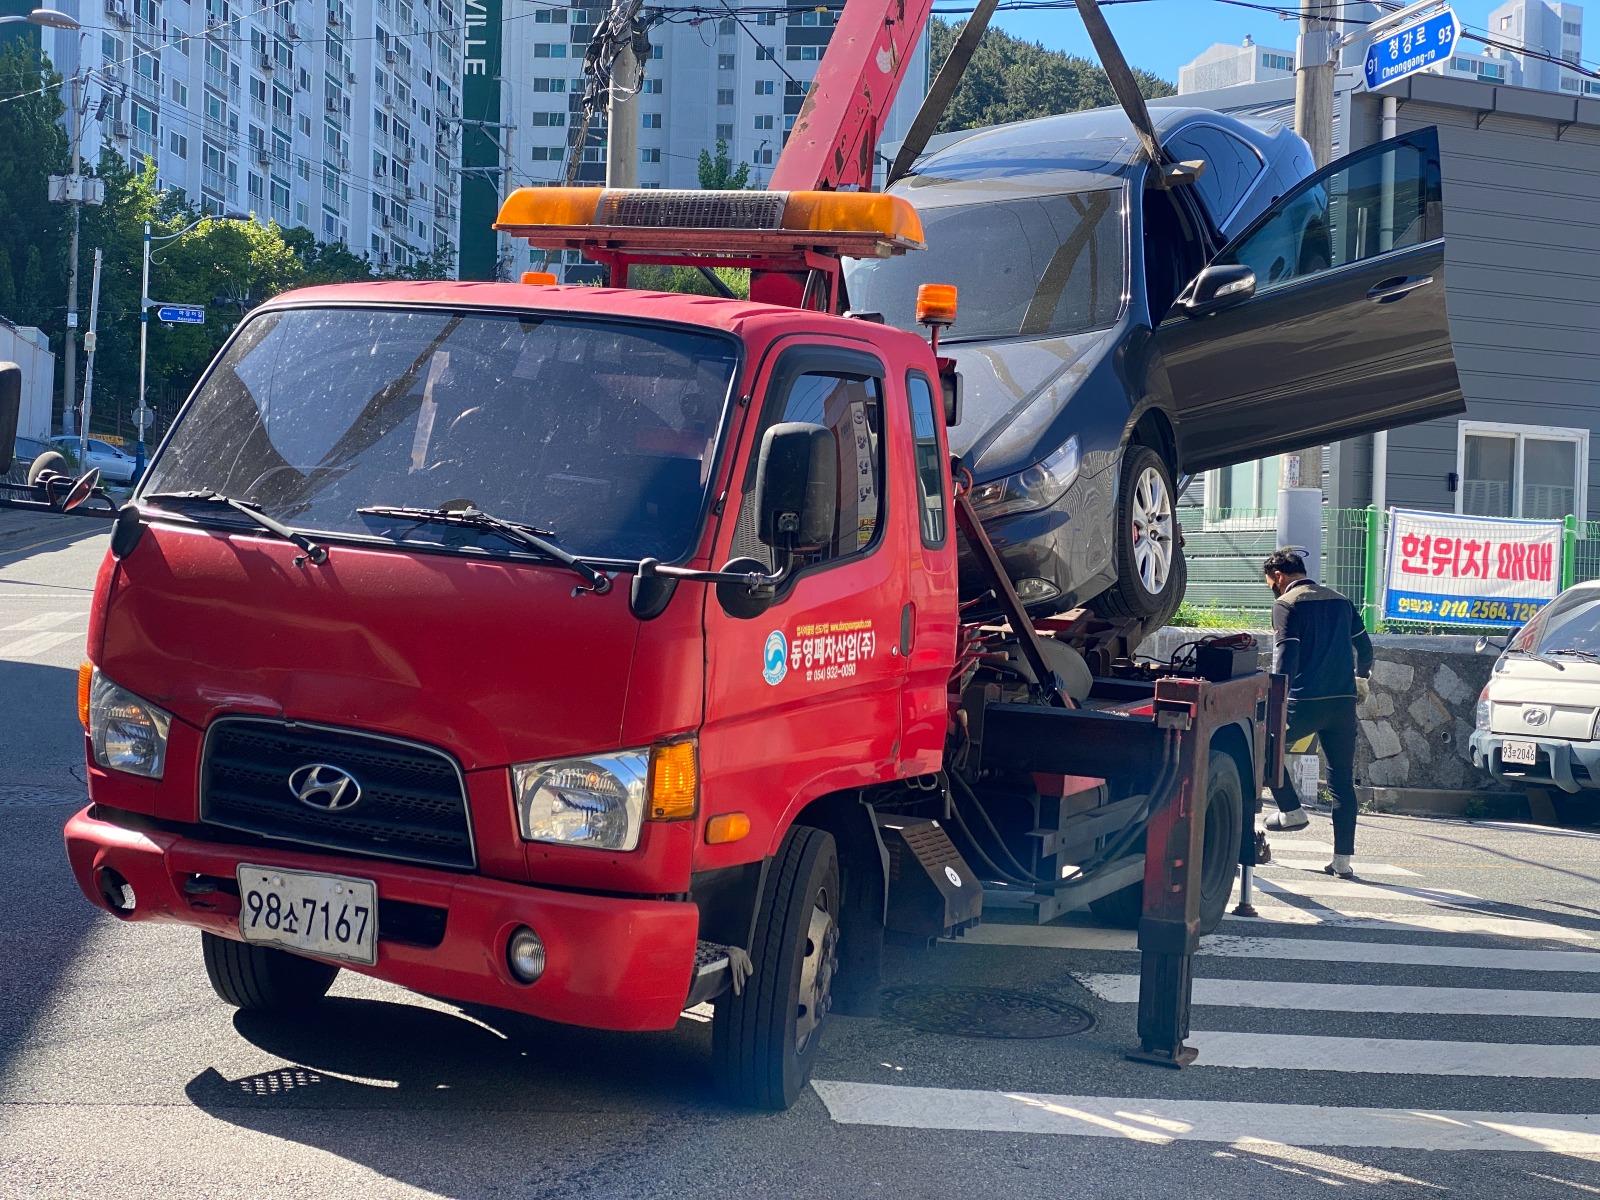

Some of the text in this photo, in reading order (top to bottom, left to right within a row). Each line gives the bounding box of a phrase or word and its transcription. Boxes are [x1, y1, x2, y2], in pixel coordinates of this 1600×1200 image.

[1388, 27, 1426, 60] 청강로
[1438, 25, 1452, 45] 93
[1367, 56, 1378, 76] 91
[1382, 49, 1436, 79] Cheonggang-ro
[1401, 532, 1552, 582] 현위치 매매
[790, 630, 876, 670] 동영폐차산업(주)
[246, 890, 369, 945] 98소7167
